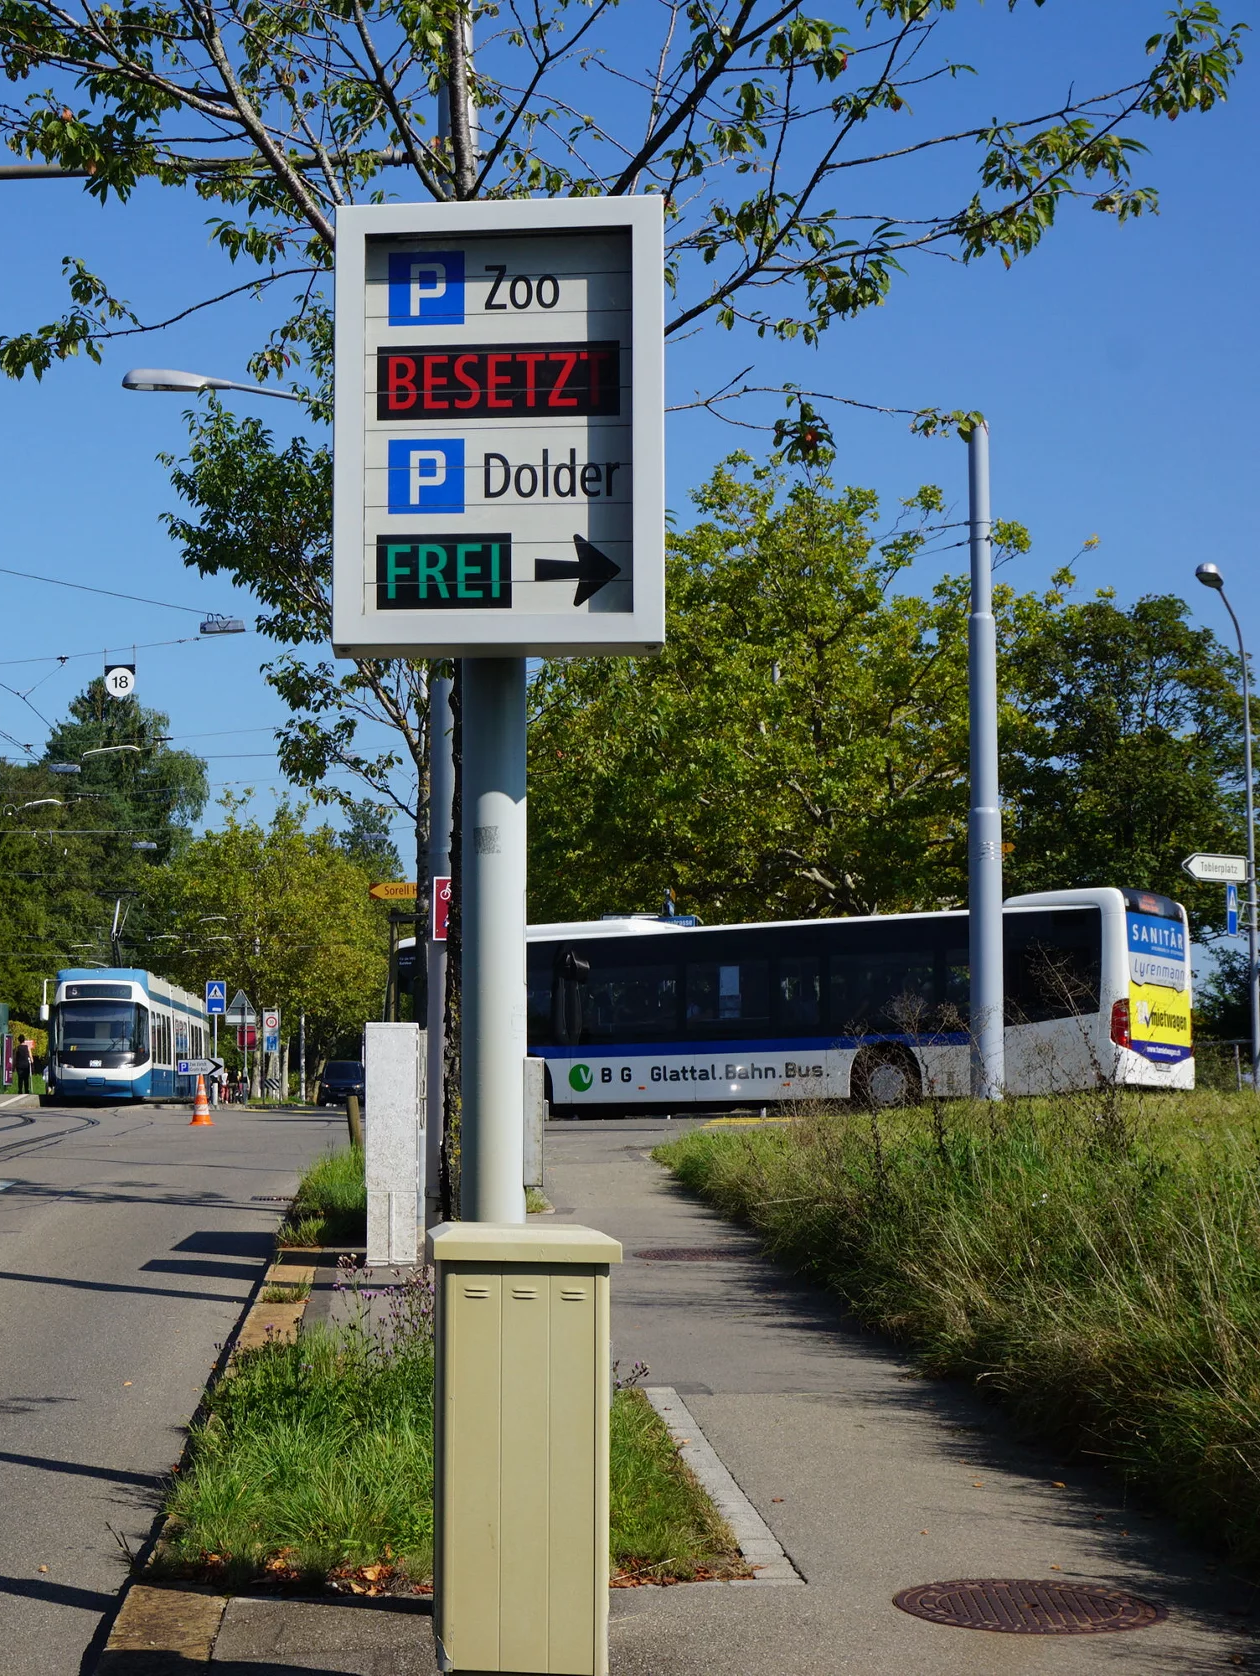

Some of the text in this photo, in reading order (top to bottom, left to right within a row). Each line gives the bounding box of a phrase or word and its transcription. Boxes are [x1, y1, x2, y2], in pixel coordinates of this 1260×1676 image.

[409, 262, 560, 317] P Zoo
[387, 352, 612, 410] BESETZT
[409, 448, 621, 505] P Dolder
[386, 543, 501, 599] FREI
[112, 675, 128, 689] 18
[1200, 861, 1238, 875] Toblerplatz
[384, 885, 410, 896] Sorell
[1134, 958, 1185, 981] Lyrenmann
[71, 987, 78, 995] 5
[1151, 1008, 1187, 1032] mietwagen
